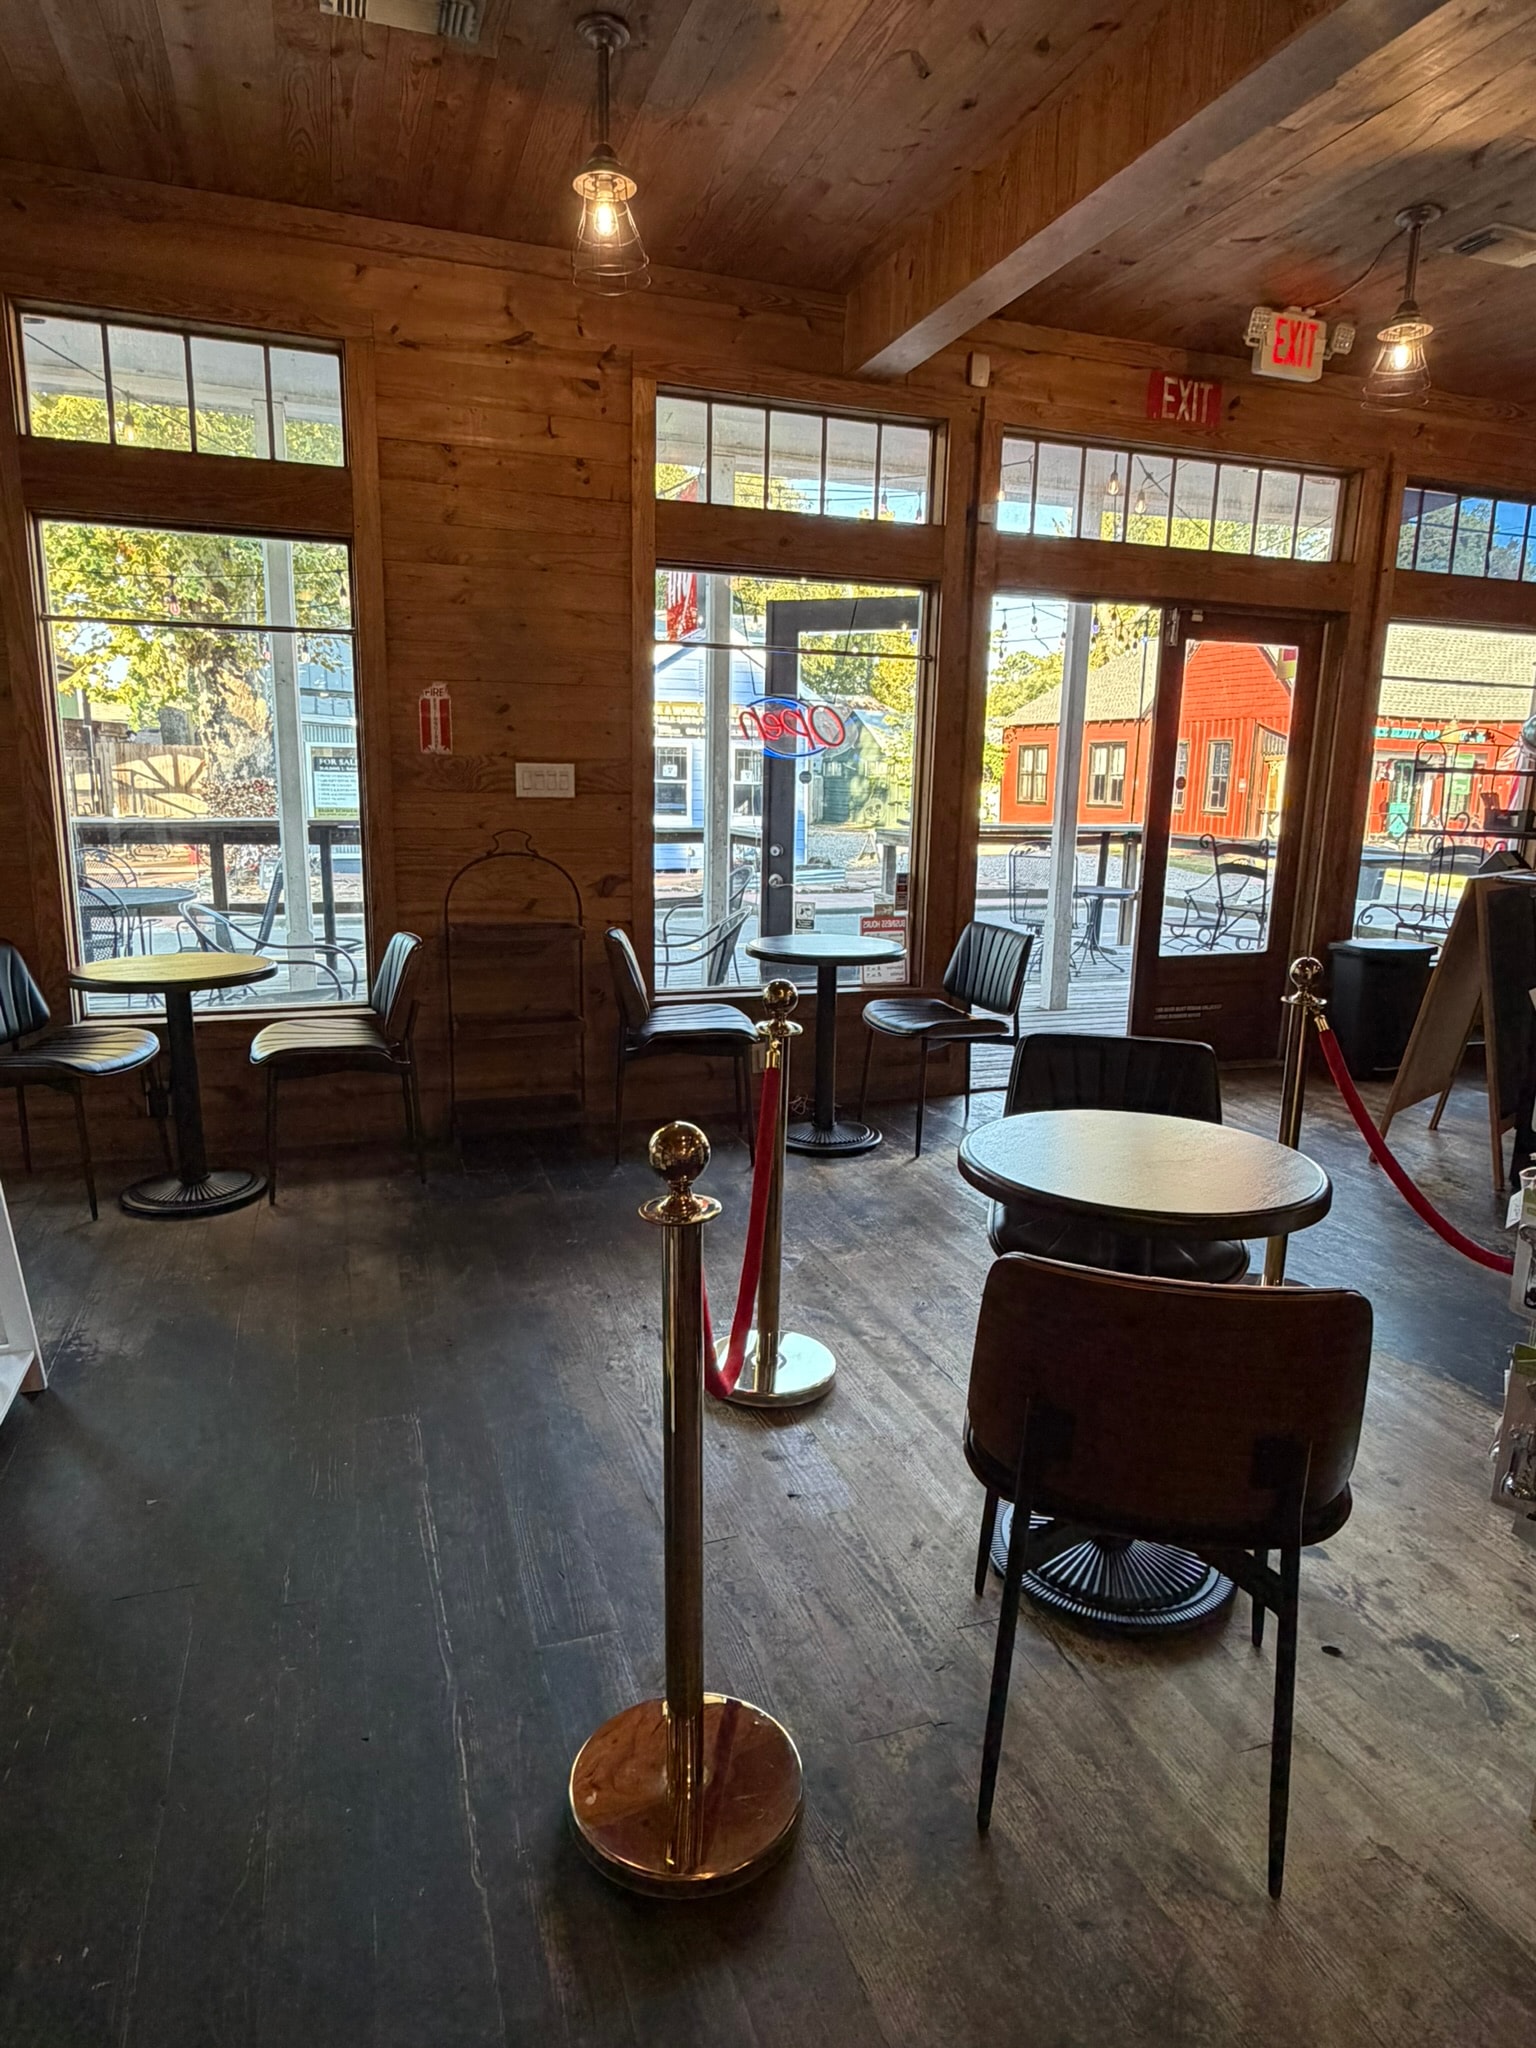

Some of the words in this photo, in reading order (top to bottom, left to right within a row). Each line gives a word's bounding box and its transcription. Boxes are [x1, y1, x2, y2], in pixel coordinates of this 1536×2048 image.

[1272, 318, 1319, 369] EXIT
[1162, 376, 1213, 423] EXIT
[319, 758, 337, 766] FOR
